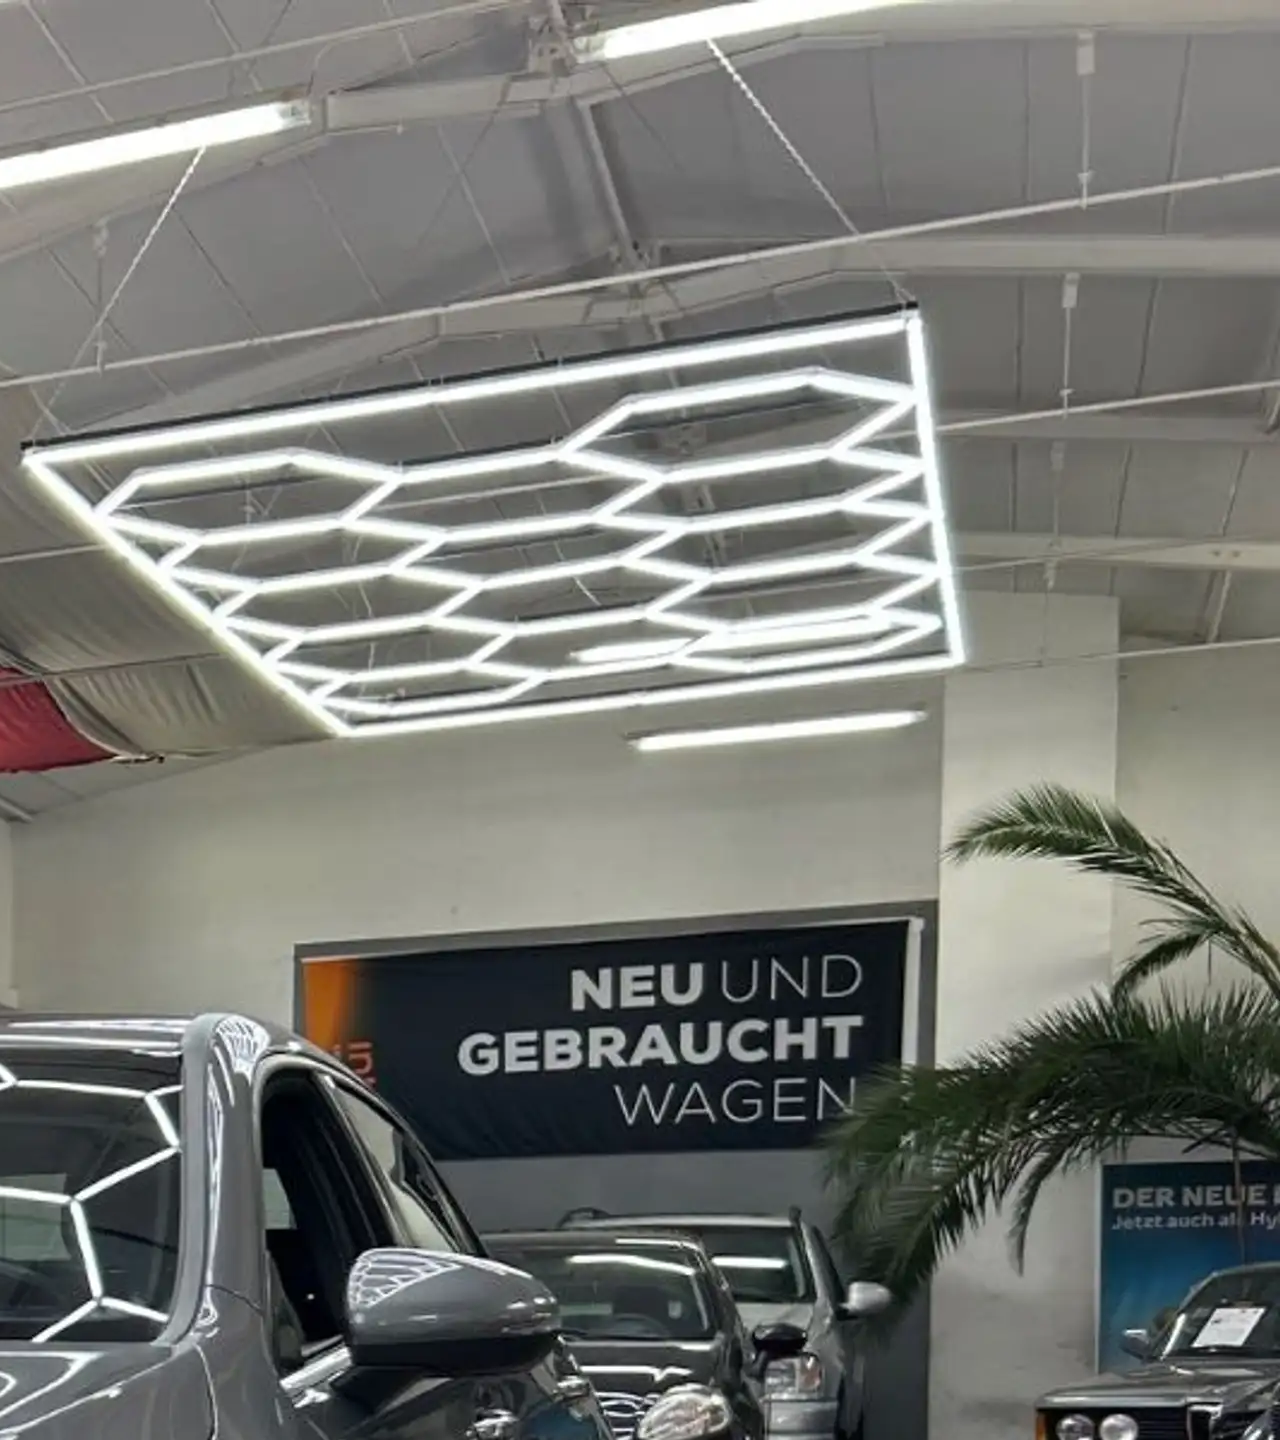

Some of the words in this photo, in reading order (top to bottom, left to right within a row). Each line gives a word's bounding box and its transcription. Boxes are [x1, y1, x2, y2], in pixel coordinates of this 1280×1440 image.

[571, 963, 703, 1011] NEU
[721, 955, 862, 1002] UND
[458, 1015, 863, 1076] GEBRAUCHT
[613, 1077, 856, 1126] WAGEN
[1112, 1187, 1175, 1208] DER
[1181, 1184, 1268, 1206] NEUE
[1111, 1214, 1165, 1230] Jetzt
[1167, 1211, 1214, 1228] auch
[1218, 1211, 1242, 1227] al
[1251, 1211, 1280, 1231] Hy
